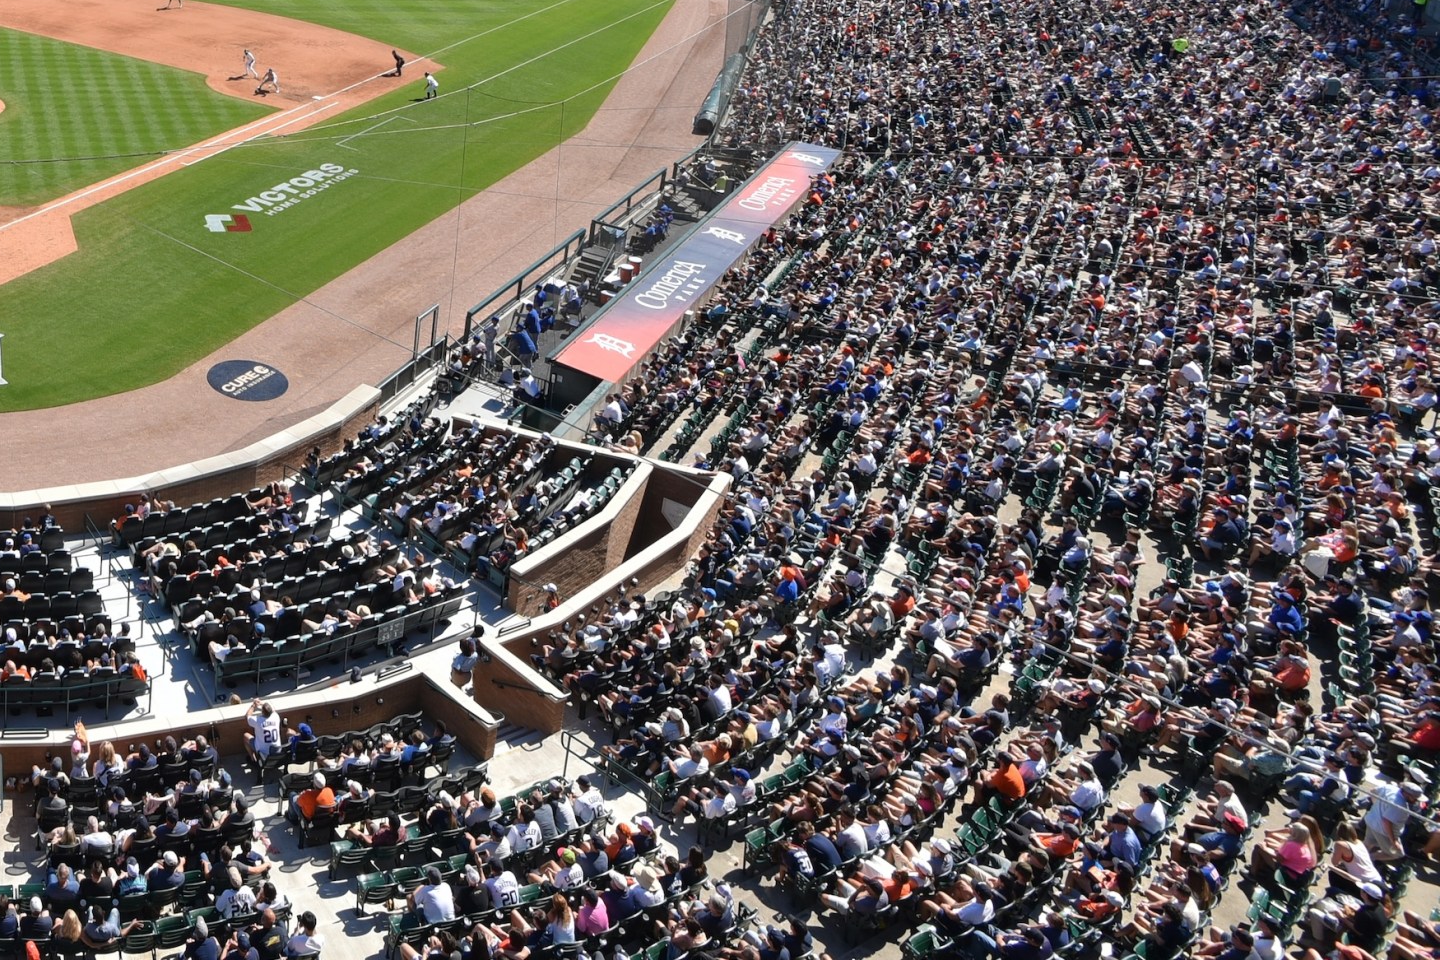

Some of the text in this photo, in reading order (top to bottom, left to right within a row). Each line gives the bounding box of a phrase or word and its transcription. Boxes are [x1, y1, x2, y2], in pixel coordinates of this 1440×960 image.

[231, 163, 344, 213] VICTORS
[264, 168, 359, 216] HOME SOLUTIONS
[774, 187, 797, 207] PARK
[675, 278, 706, 302] PARK
[263, 729, 279, 744] 20
[501, 890, 518, 905] 20
[232, 903, 249, 916] 24
